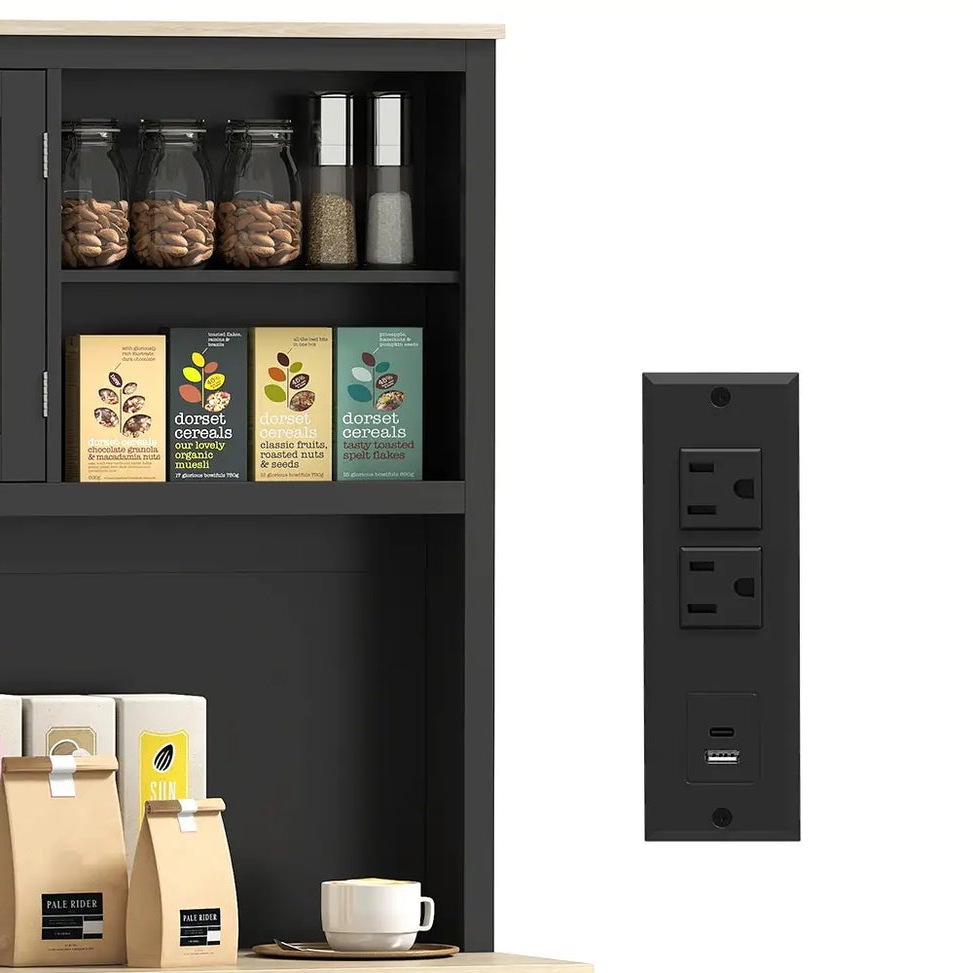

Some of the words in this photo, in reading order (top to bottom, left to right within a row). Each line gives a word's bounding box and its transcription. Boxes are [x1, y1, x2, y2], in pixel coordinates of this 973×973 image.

[174, 412, 226, 425] dorset
[260, 412, 312, 425] dorset
[342, 412, 400, 424] dorset
[174, 426, 233, 439] cereals
[260, 426, 317, 439] cereals
[342, 426, 407, 438] cereals
[128, 446, 158, 454] granola
[195, 440, 226, 451] lovely
[260, 441, 294, 450] classic
[343, 441, 372, 450] tasty
[374, 441, 414, 450] toasted
[174, 451, 214, 460] organic
[260, 450, 298, 458] roasted
[343, 451, 371, 460] spelt
[374, 451, 405, 460] flakes
[175, 460, 210, 468] muesli
[260, 460, 270, 468] &
[271, 460, 300, 468] seeds
[46, 900, 68, 909] PALE
[70, 900, 98, 908] RIDER
